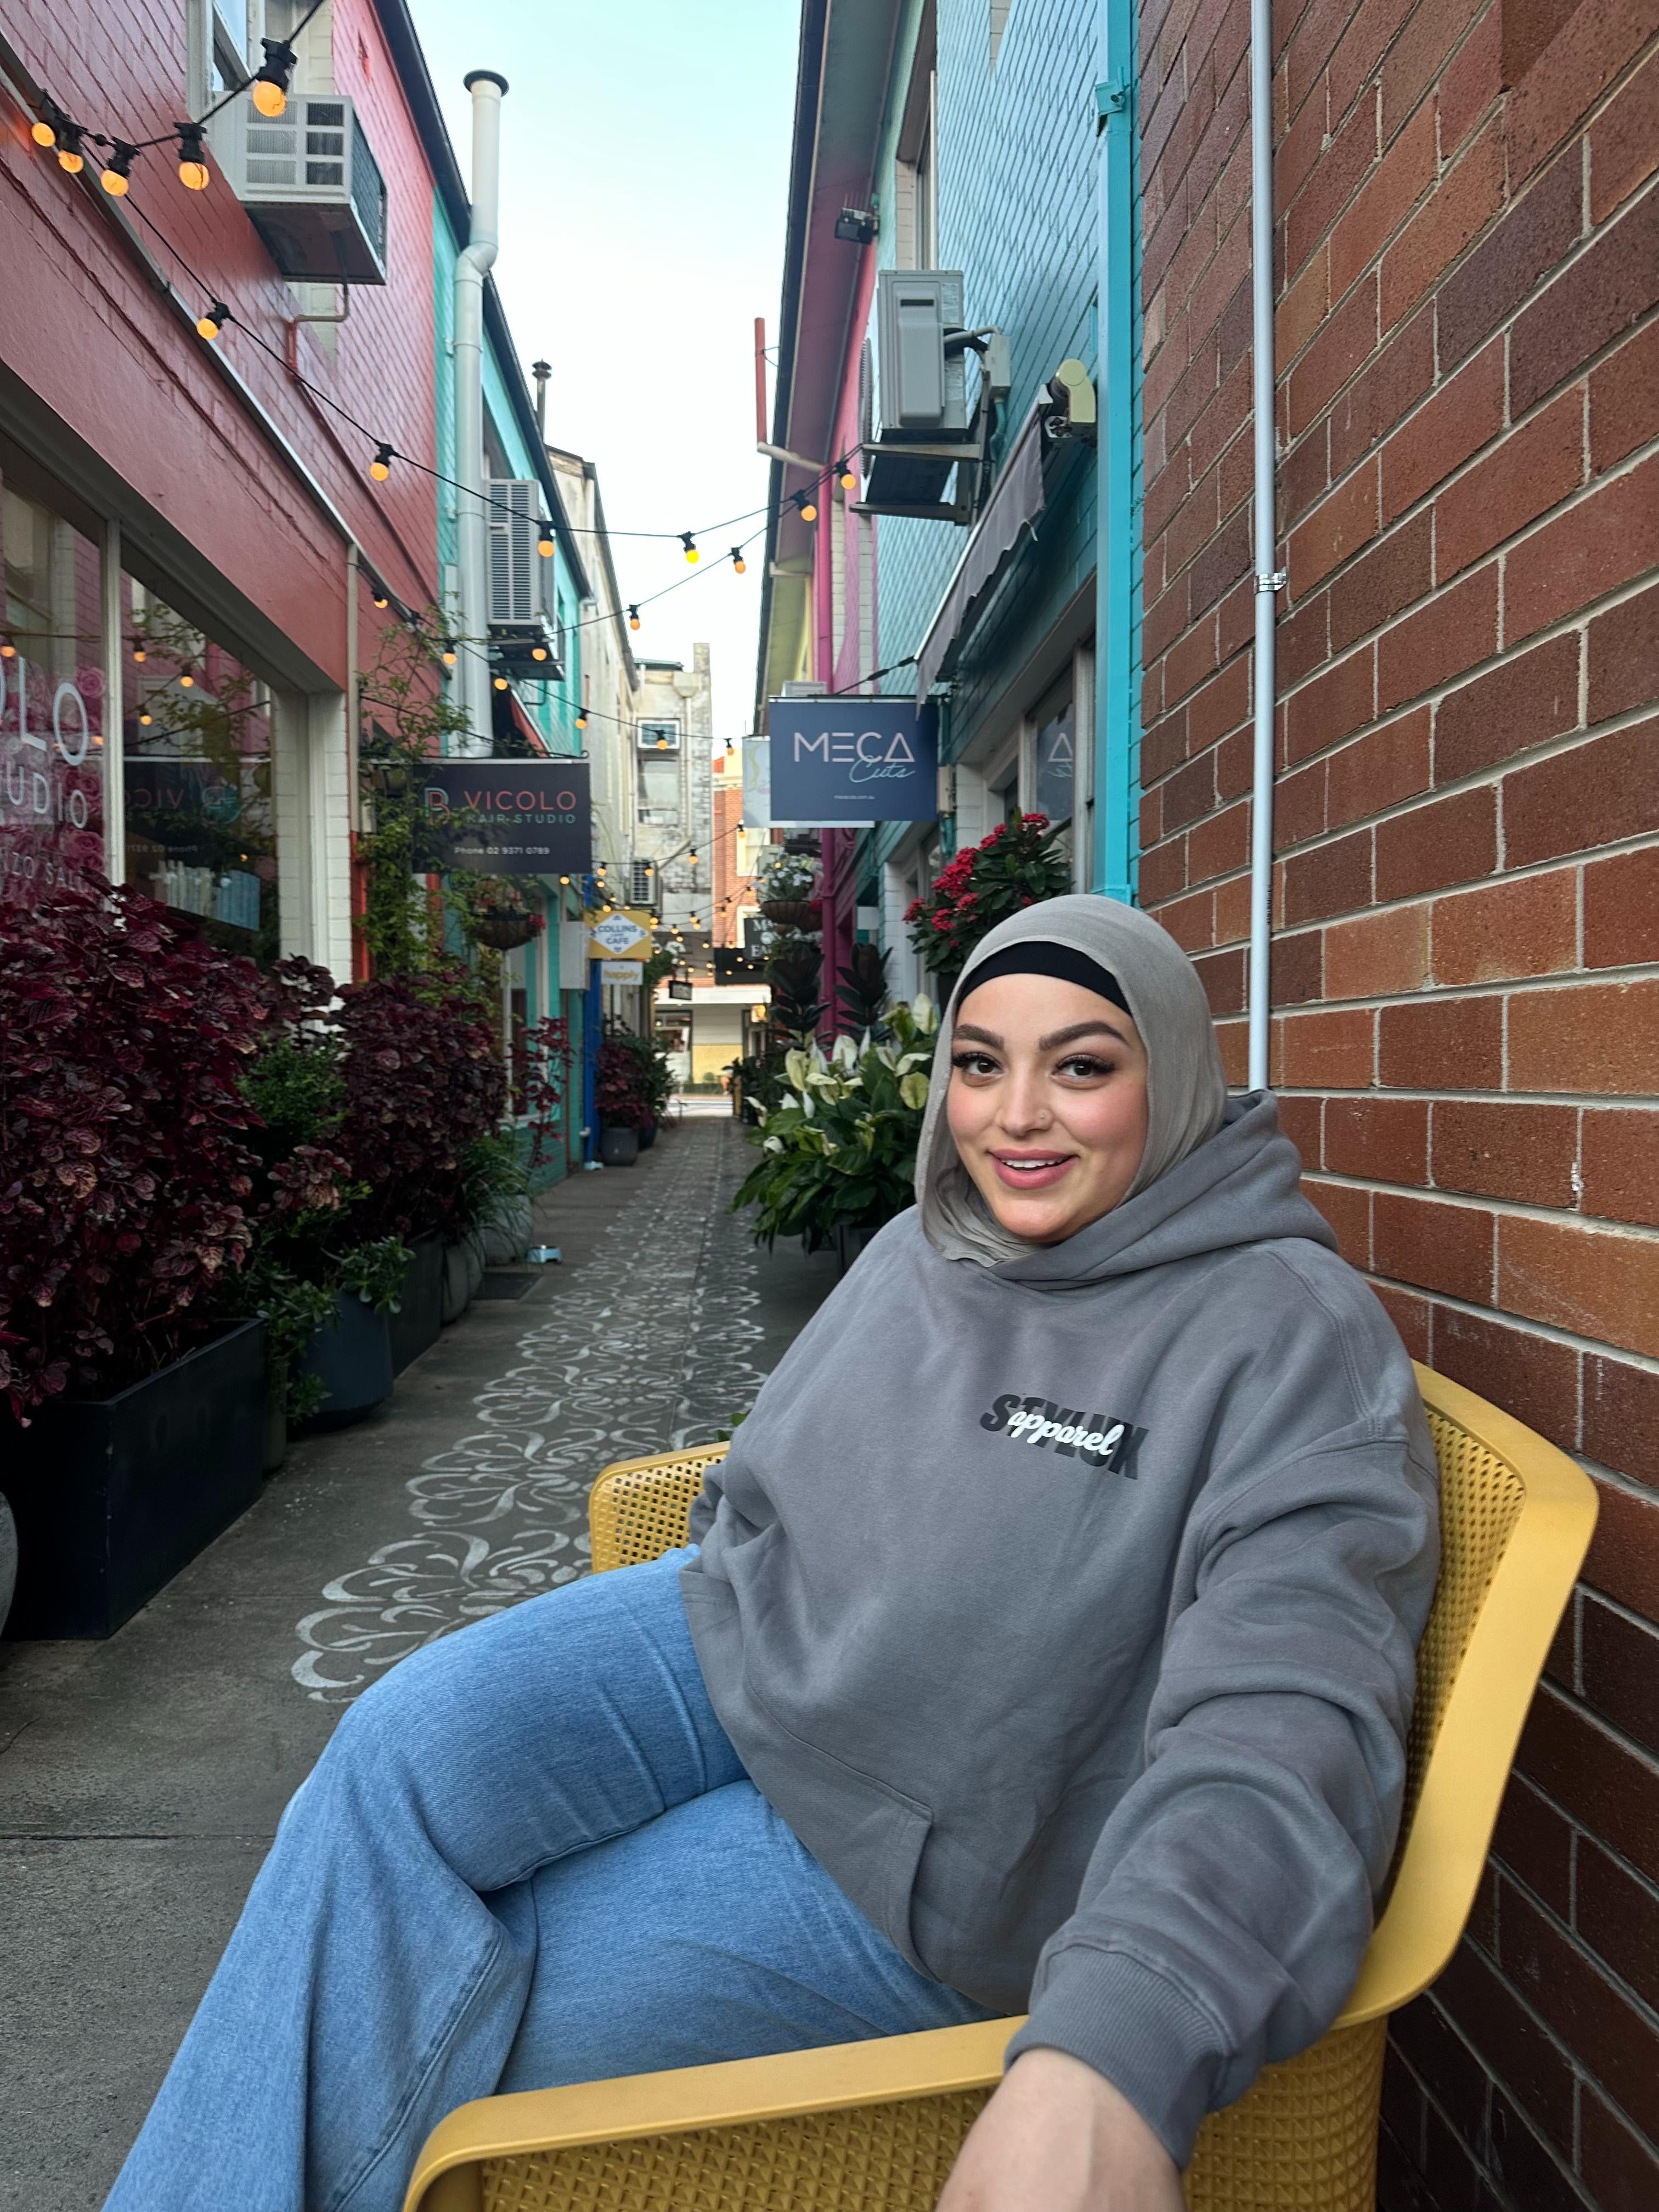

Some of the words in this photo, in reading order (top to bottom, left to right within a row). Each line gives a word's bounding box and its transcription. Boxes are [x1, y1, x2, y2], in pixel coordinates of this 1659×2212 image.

[0, 656, 88, 766] LO
[794, 732, 916, 763] MECA
[849, 755, 916, 783] Cuts
[464, 791, 576, 811] VICOLO
[515, 814, 576, 823] STUDIO
[1007, 1411, 1125, 1455] apparel
